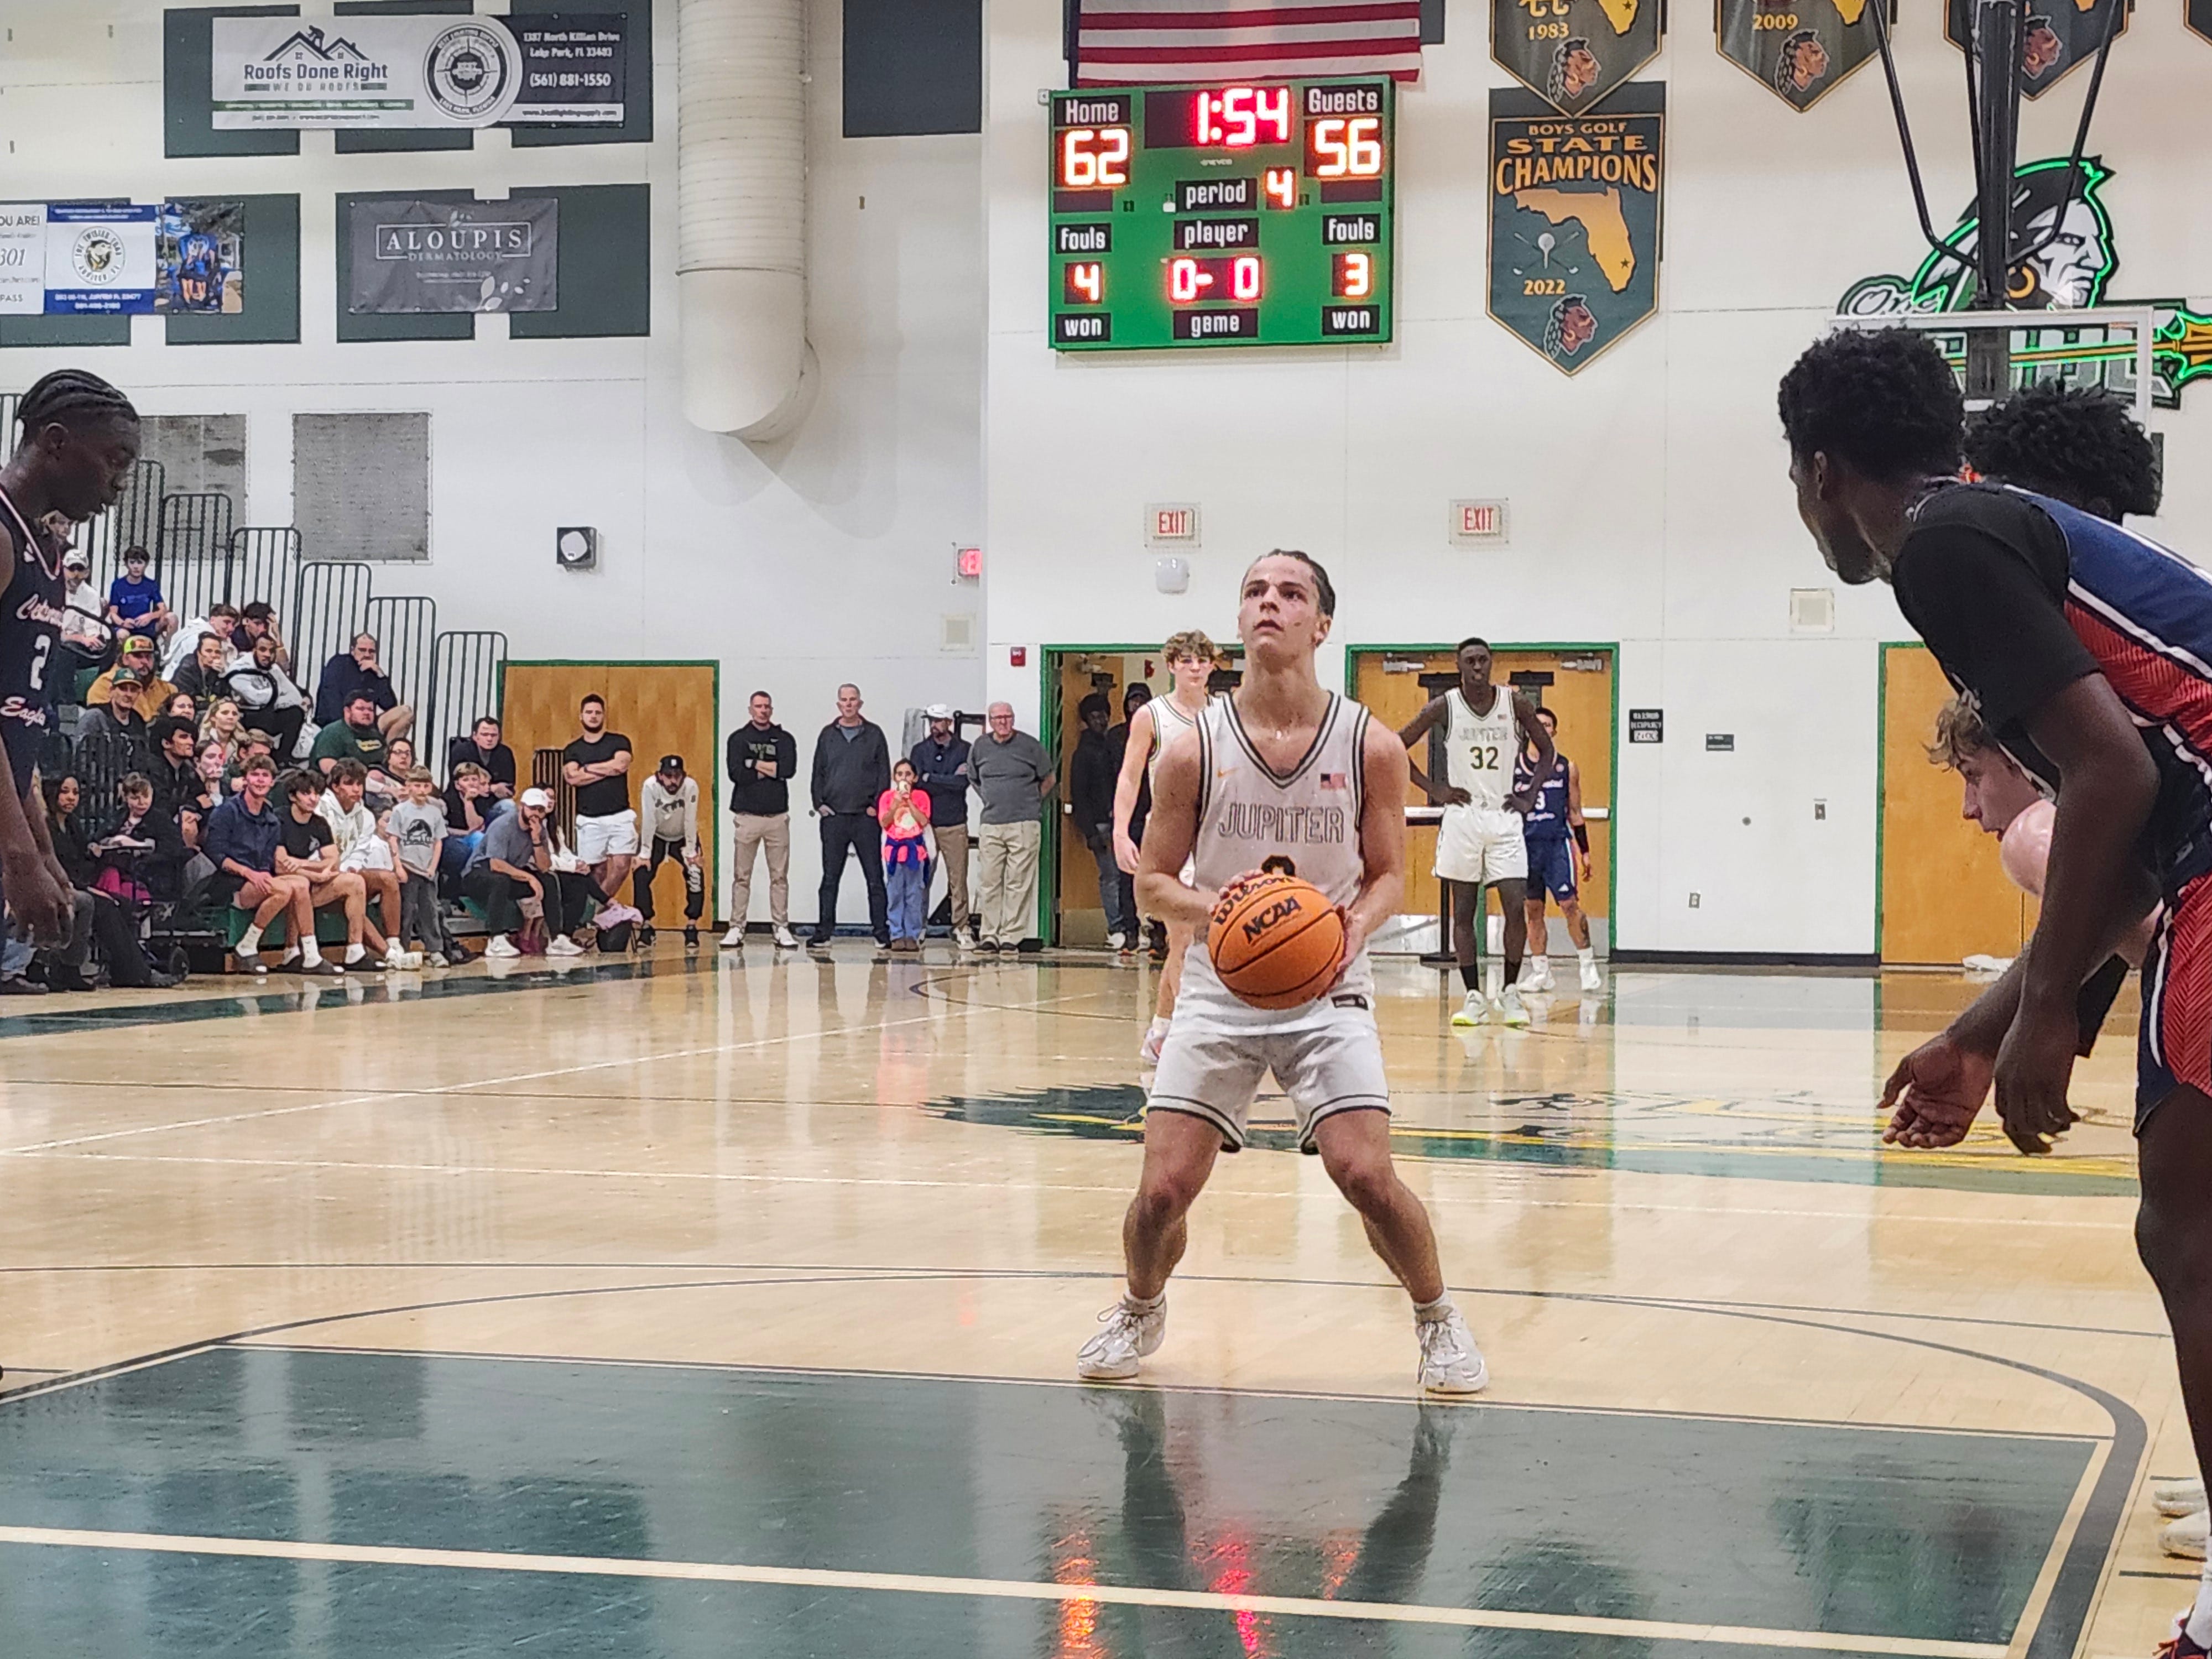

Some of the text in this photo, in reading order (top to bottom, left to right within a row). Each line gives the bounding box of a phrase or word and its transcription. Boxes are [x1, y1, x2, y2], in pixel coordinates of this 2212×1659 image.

[1528, 22, 1569, 40] 1983
[1752, 13, 1798, 30] 2009
[244, 62, 388, 81] Roofs Done Right
[530, 72, 557, 87] (561)
[273, 83, 289, 91] WE
[1066, 100, 1119, 123] Home
[1309, 88, 1378, 112] Guests
[1196, 87, 1289, 145] 1:54
[1528, 122, 1628, 135] BOYS GOLF
[1314, 118, 1381, 175] 56
[1507, 135, 1648, 154] STATE
[1065, 129, 1128, 186] 62
[1496, 153, 1656, 195] CHAMPIONS
[1186, 170, 1293, 208] period 4
[387, 229, 522, 250] ALOUPIS
[1061, 228, 1105, 249] fouls
[1185, 223, 1249, 248] player
[1328, 218, 1374, 241] fouls
[408, 251, 502, 262] DERMATOLOGY
[1074, 264, 1100, 302] 4
[1234, 257, 1259, 299] 0
[1344, 254, 1369, 295] 3
[1524, 279, 1566, 295] 2022
[1065, 319, 1102, 336] won
[1191, 314, 1239, 337] game
[1332, 311, 1370, 329] won
[1159, 511, 1187, 534] EXIT
[1464, 508, 1494, 530] EXIT
[30, 635, 51, 690] 2
[1470, 747, 1499, 770] 32
[1535, 791, 1546, 810] 3
[1218, 803, 1344, 844] JUPITER
[1242, 896, 1302, 944] NCAA
